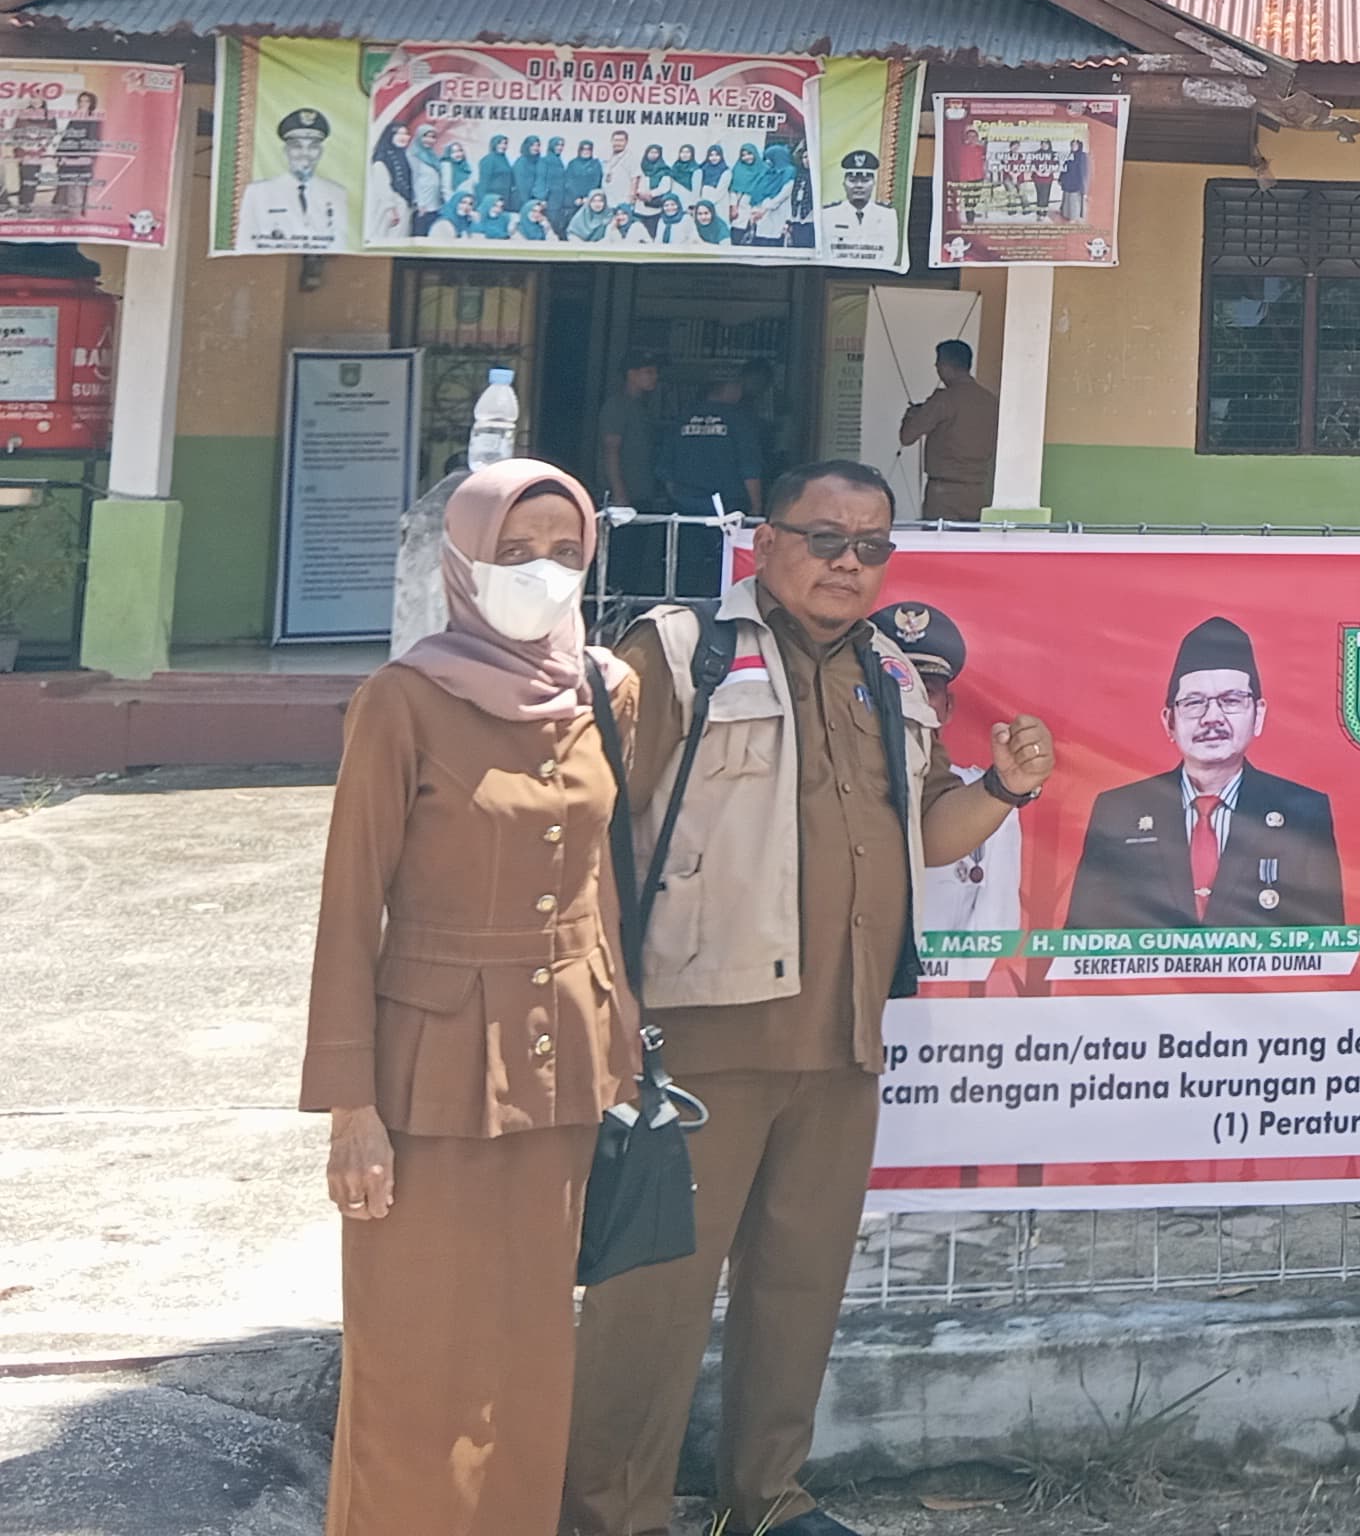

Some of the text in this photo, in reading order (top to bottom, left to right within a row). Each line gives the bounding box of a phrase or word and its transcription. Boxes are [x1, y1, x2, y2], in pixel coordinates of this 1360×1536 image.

[528, 60, 693, 81] DIRGAHAYU
[0, 81, 64, 100] SKO
[443, 79, 775, 109] REPUBLIK INDONESIA KE-78
[488, 105, 582, 124] KELURAHAN
[588, 108, 635, 125] TELUK
[640, 110, 709, 127] MAKMUR
[941, 935, 1003, 954] MARS
[1032, 933, 1055, 952] H.
[1062, 932, 1132, 952] INDRA
[1138, 931, 1263, 953] GUNAWAN,
[921, 959, 950, 977] MAI
[1073, 955, 1322, 976] SEKRETARIS DAERAH KOTA DUMAI
[918, 1041, 1004, 1069] orang
[1014, 1034, 1147, 1064] dan/atau
[1158, 1031, 1248, 1060] Badan
[1258, 1035, 1326, 1064] yang
[881, 1080, 939, 1106] cam
[949, 1077, 1060, 1110] dengan
[1069, 1073, 1170, 1108] pidana
[1180, 1070, 1316, 1103] kurungan
[1212, 1111, 1249, 1145] (1)
